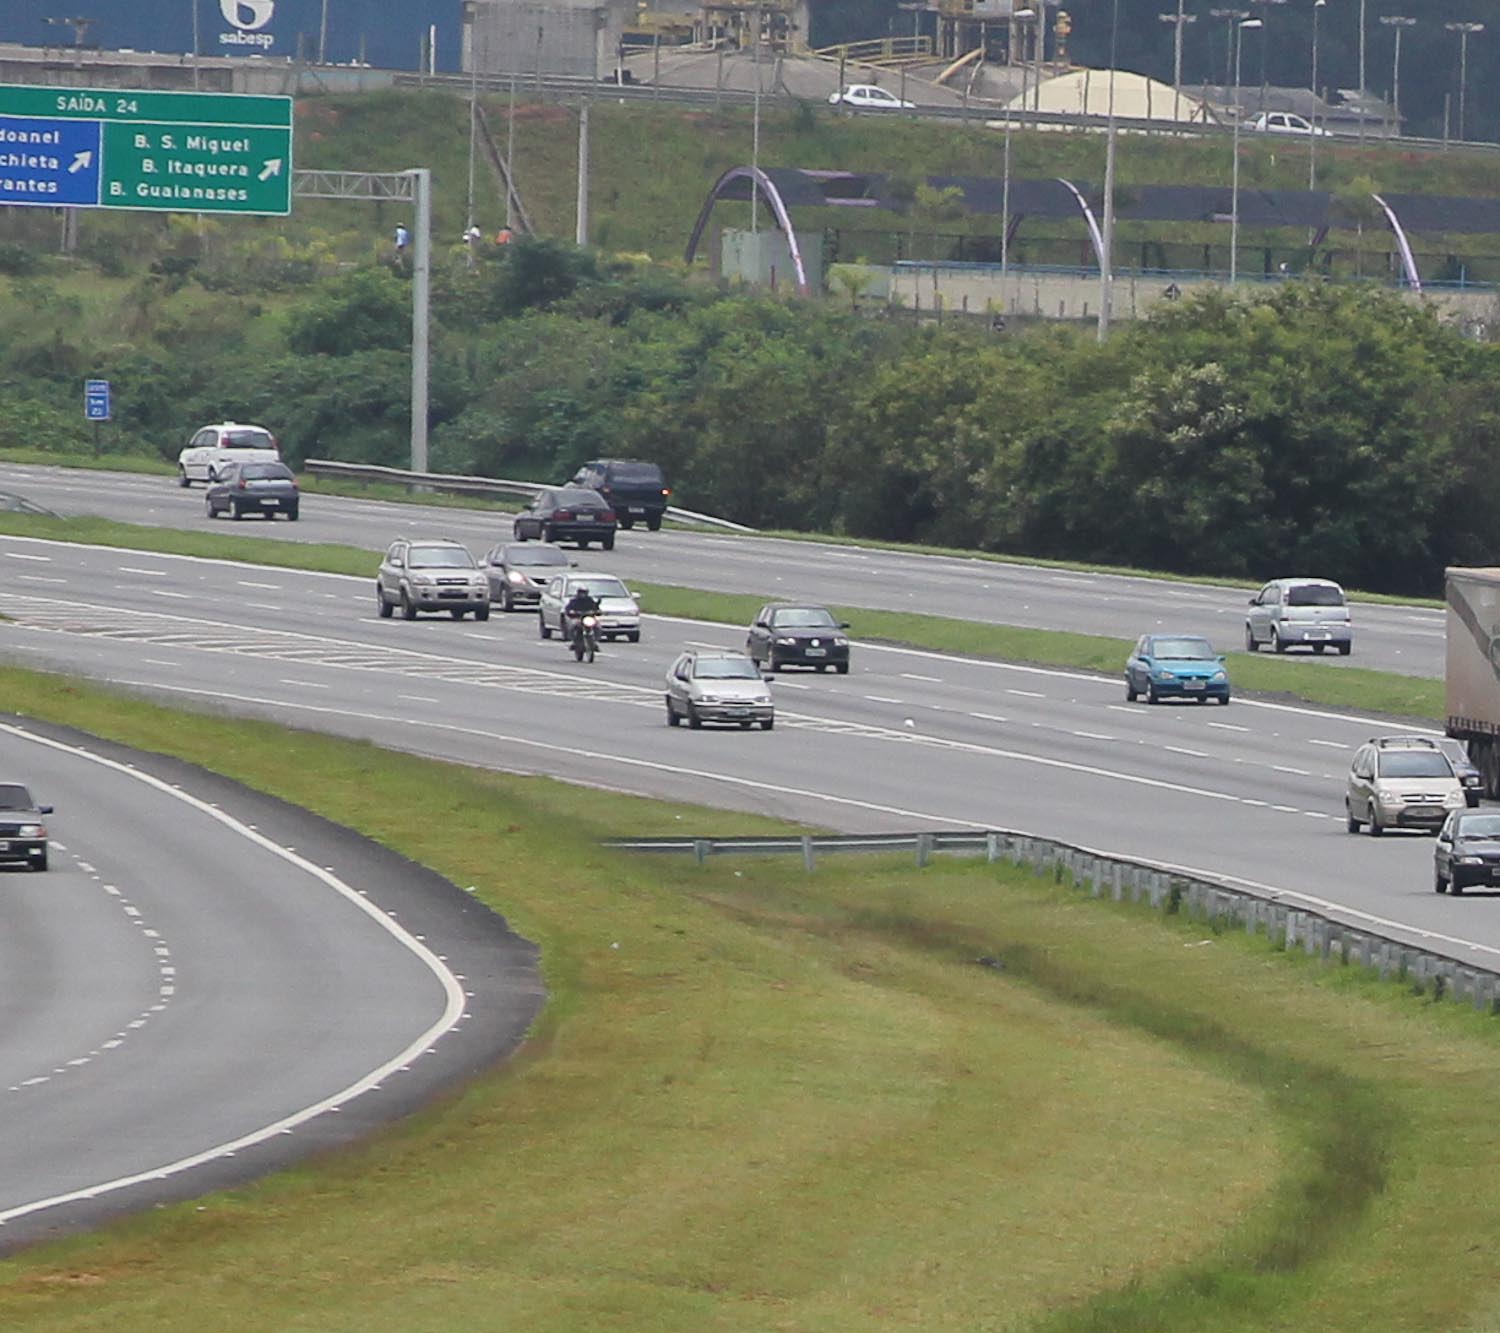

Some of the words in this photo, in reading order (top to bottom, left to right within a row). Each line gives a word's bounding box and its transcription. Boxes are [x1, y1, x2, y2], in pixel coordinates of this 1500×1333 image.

[219, 31, 274, 48] sabesp
[57, 93, 106, 112] SAÍDA
[116, 100, 138, 113] 24
[134, 135, 150, 148] B.
[161, 135, 177, 149] S.
[186, 136, 249, 154] Miguel
[142, 159, 158, 173] B.
[168, 160, 248, 178] Itaquera
[0, 178, 58, 193] antes
[110, 182, 126, 196] B.
[137, 182, 248, 201] Guaianases
